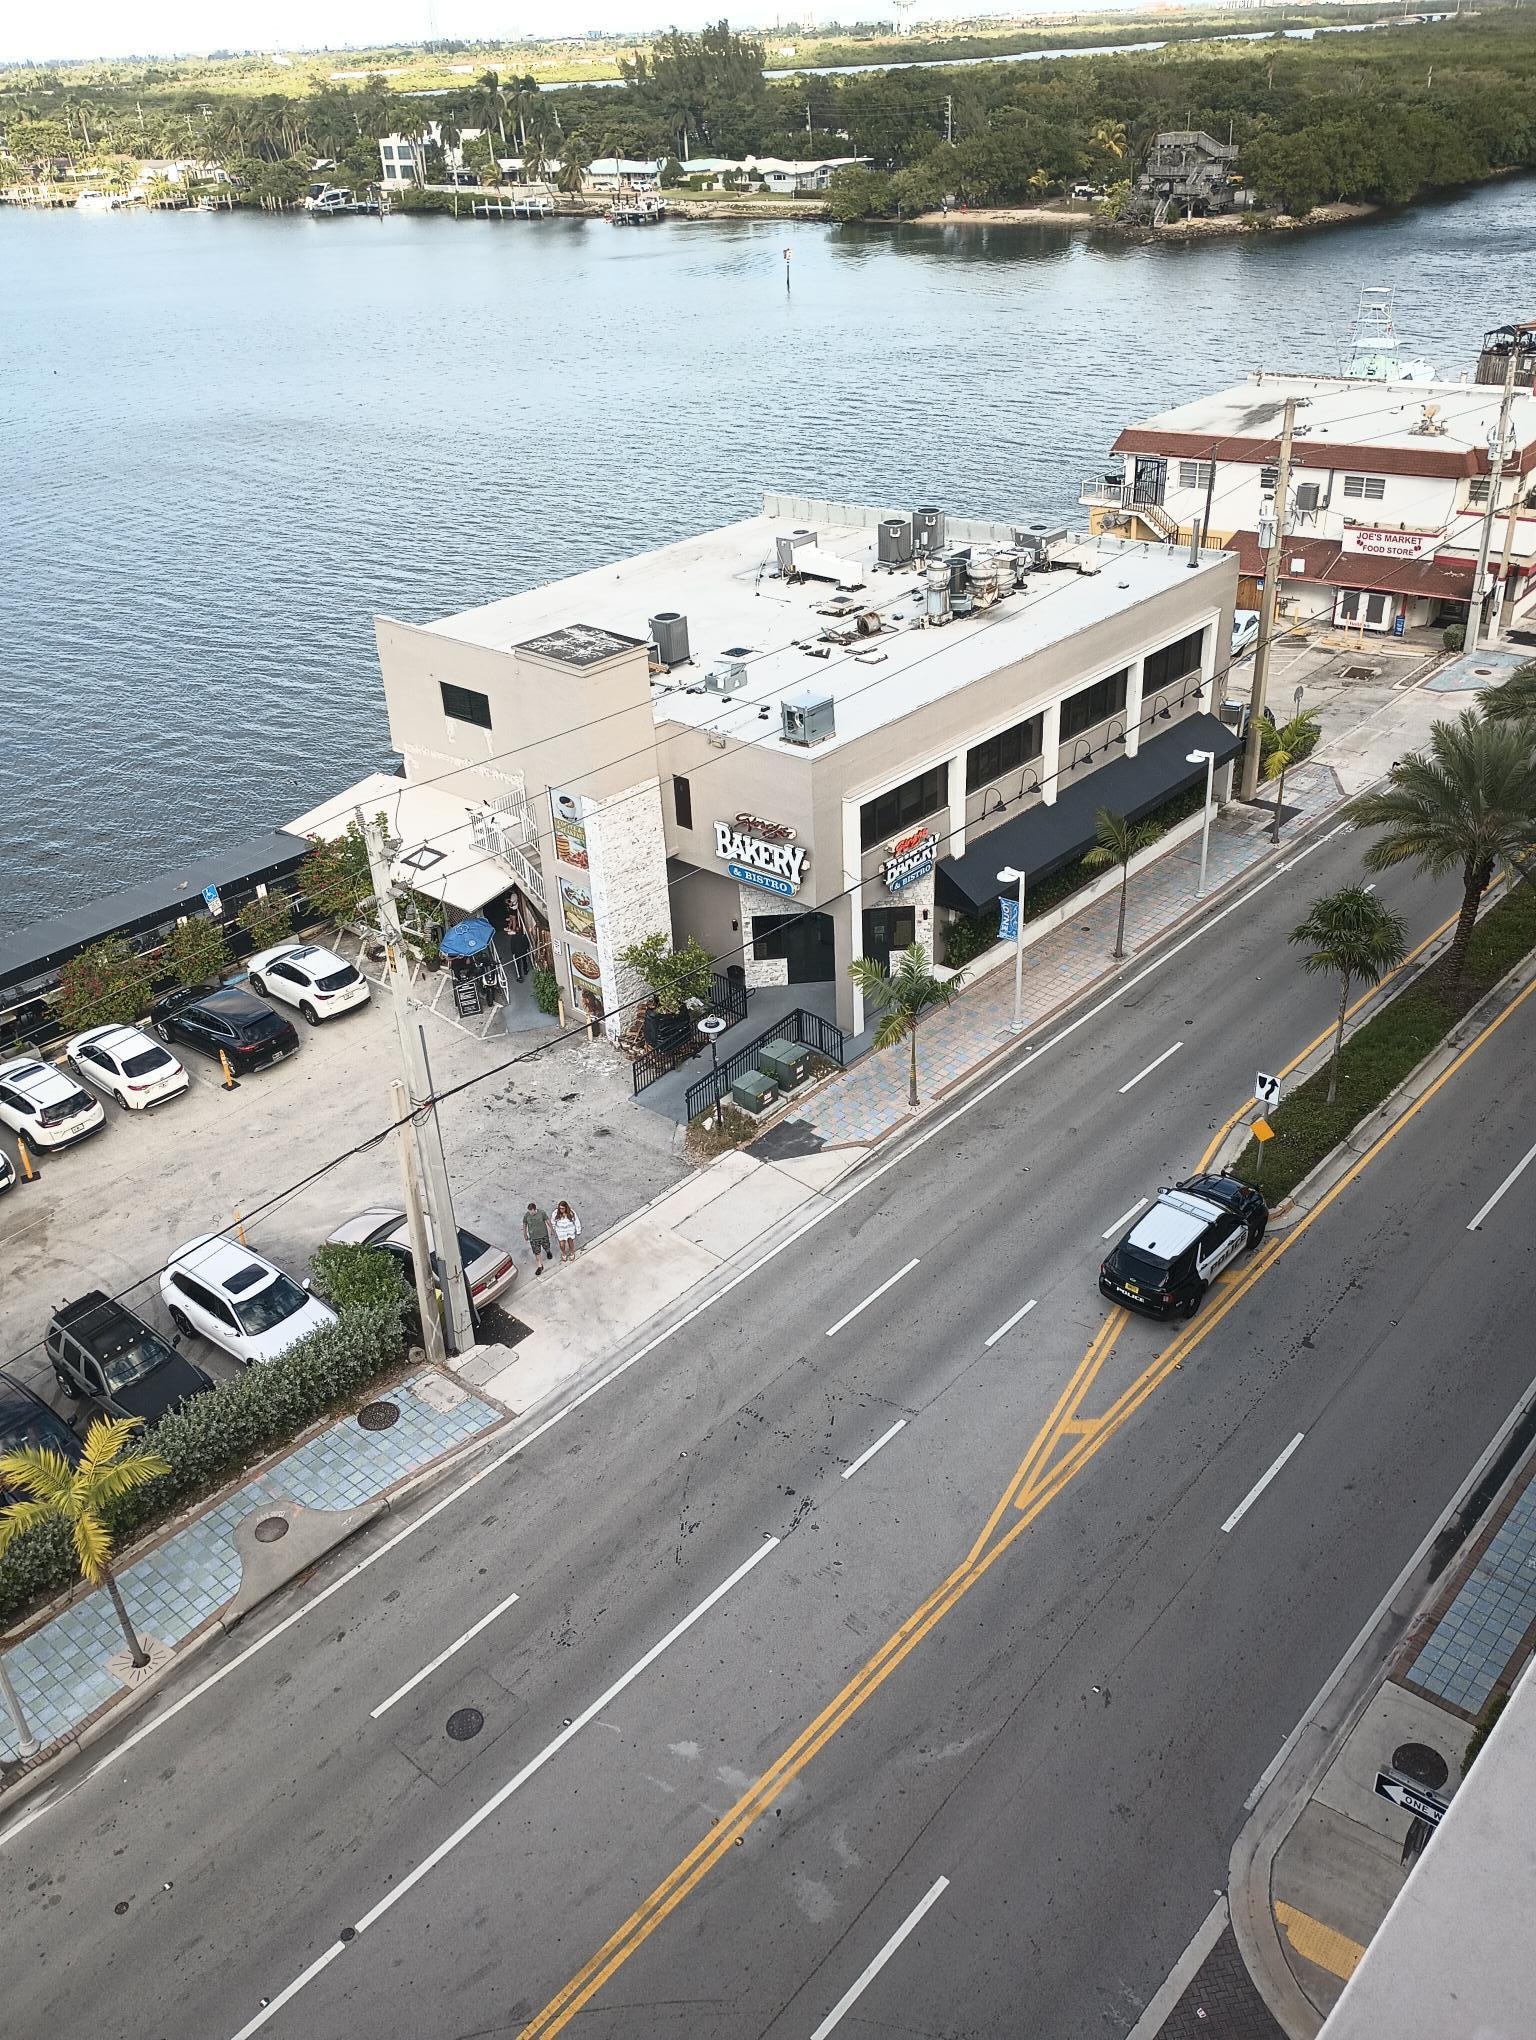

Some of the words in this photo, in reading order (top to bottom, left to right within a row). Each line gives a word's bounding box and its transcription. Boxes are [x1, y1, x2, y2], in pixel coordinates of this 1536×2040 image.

[1356, 532, 1383, 541] JOE'S
[1384, 534, 1423, 545] MARKET
[1362, 544, 1385, 553] FOOD
[1386, 547, 1414, 556] STORE
[713, 820, 806, 884] BAKERY
[733, 867, 742, 877] &
[745, 870, 788, 892] BISTRO
[902, 864, 932, 886] BISTRO
[1210, 1230, 1248, 1275] POLICE
[1116, 1286, 1145, 1303] POLICE
[1405, 1796, 1429, 1815] ONE
